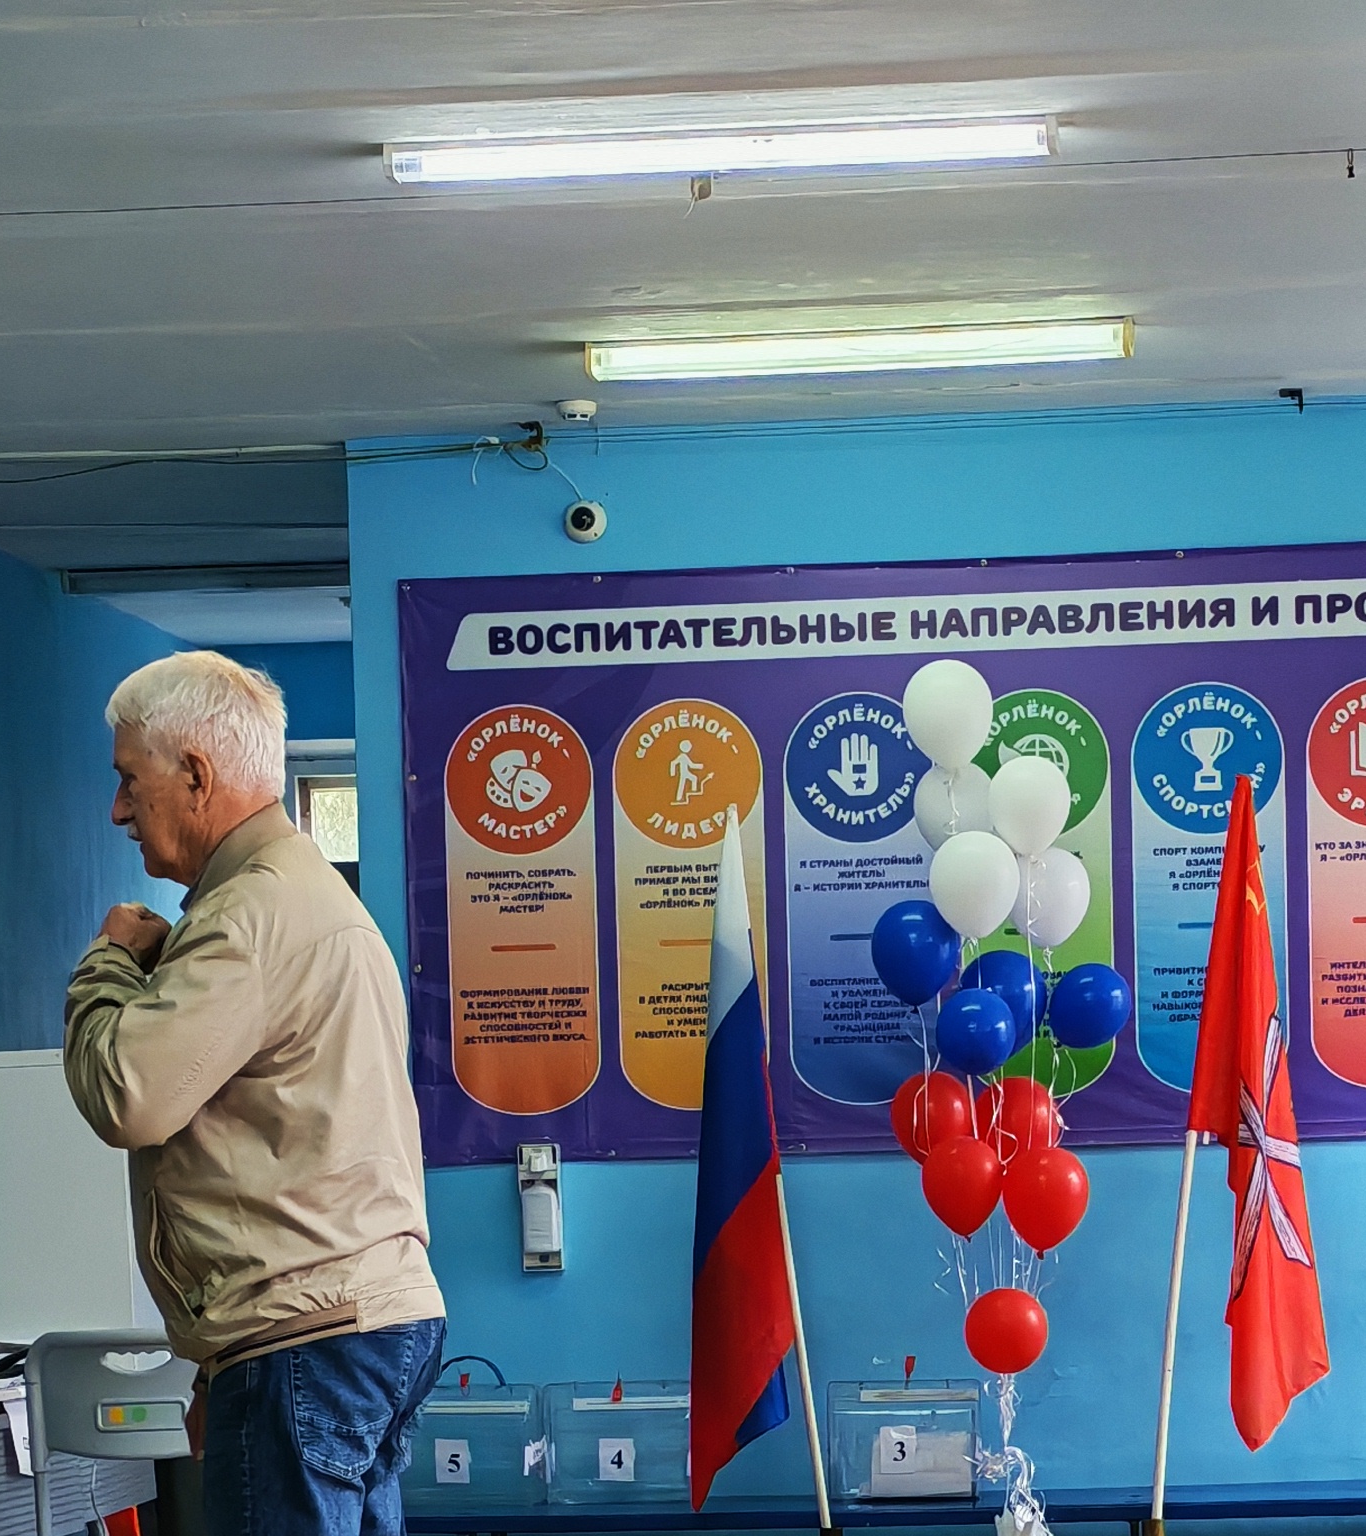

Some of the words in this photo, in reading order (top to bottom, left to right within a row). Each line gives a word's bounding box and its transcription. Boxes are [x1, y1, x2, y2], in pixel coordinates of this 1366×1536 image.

[488, 611, 897, 656] ВОСПИТАТЕЛЬНЫЕ
[910, 597, 1235, 640] НАПРАВЛЕНИЯ
[1252, 595, 1280, 627] И
[804, 772, 915, 825] ХРАНИТЕЛЬ»
[478, 805, 568, 840] МАСТЕР»
[647, 811, 727, 840] ЛИДЕР
[1315, 842, 1336, 850] КТО
[1338, 841, 1352, 850] ЗА
[1153, 847, 1187, 856] СПОРТ
[809, 859, 852, 868] СТРАНЫ
[855, 854, 923, 867] ДОСТОЙНЫЙ
[1185, 858, 1222, 867] ВЗАМЕ
[1320, 854, 1327, 862] Я
[646, 864, 692, 874] ПЕРВЫМ
[1169, 871, 1176, 879] Я
[489, 881, 555, 891] РАСКРАСИТЬ
[634, 877, 679, 886] ПРИМЕР
[681, 876, 701, 885] МЫ
[794, 884, 801, 892] Я
[813, 882, 862, 892] ИСТОРИИ
[662, 888, 670, 897] Я
[672, 888, 687, 896] ВО
[471, 894, 491, 903] ЭТО
[493, 894, 500, 903] Я
[1153, 967, 1208, 976] ПРИВИТИ
[661, 983, 710, 991] РАСКРЫТ
[841, 988, 889, 998] УВАЖЕН
[652, 1006, 708, 1016] СПОСОБНО
[635, 1030, 687, 1039] РАБОТАТЬ
[893, 1441, 906, 1461] 3
[447, 1453, 461, 1473] 5
[610, 1449, 624, 1469] 4
